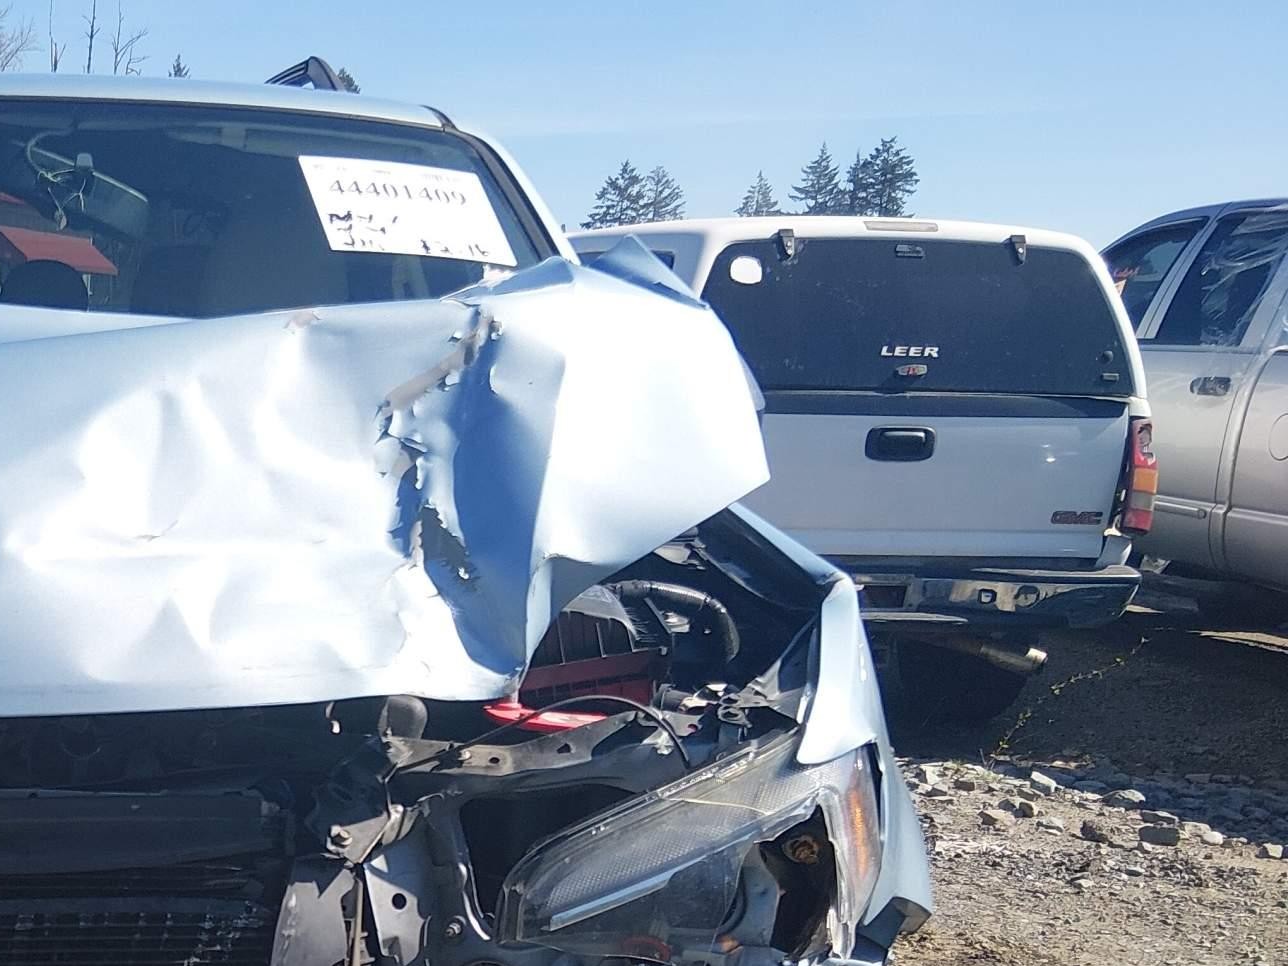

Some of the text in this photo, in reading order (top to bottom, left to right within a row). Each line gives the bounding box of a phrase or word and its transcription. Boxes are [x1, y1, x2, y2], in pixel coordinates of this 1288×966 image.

[328, 179, 467, 205] 44401409
[880, 345, 939, 358] LEER
[1051, 510, 1104, 525] GMC
